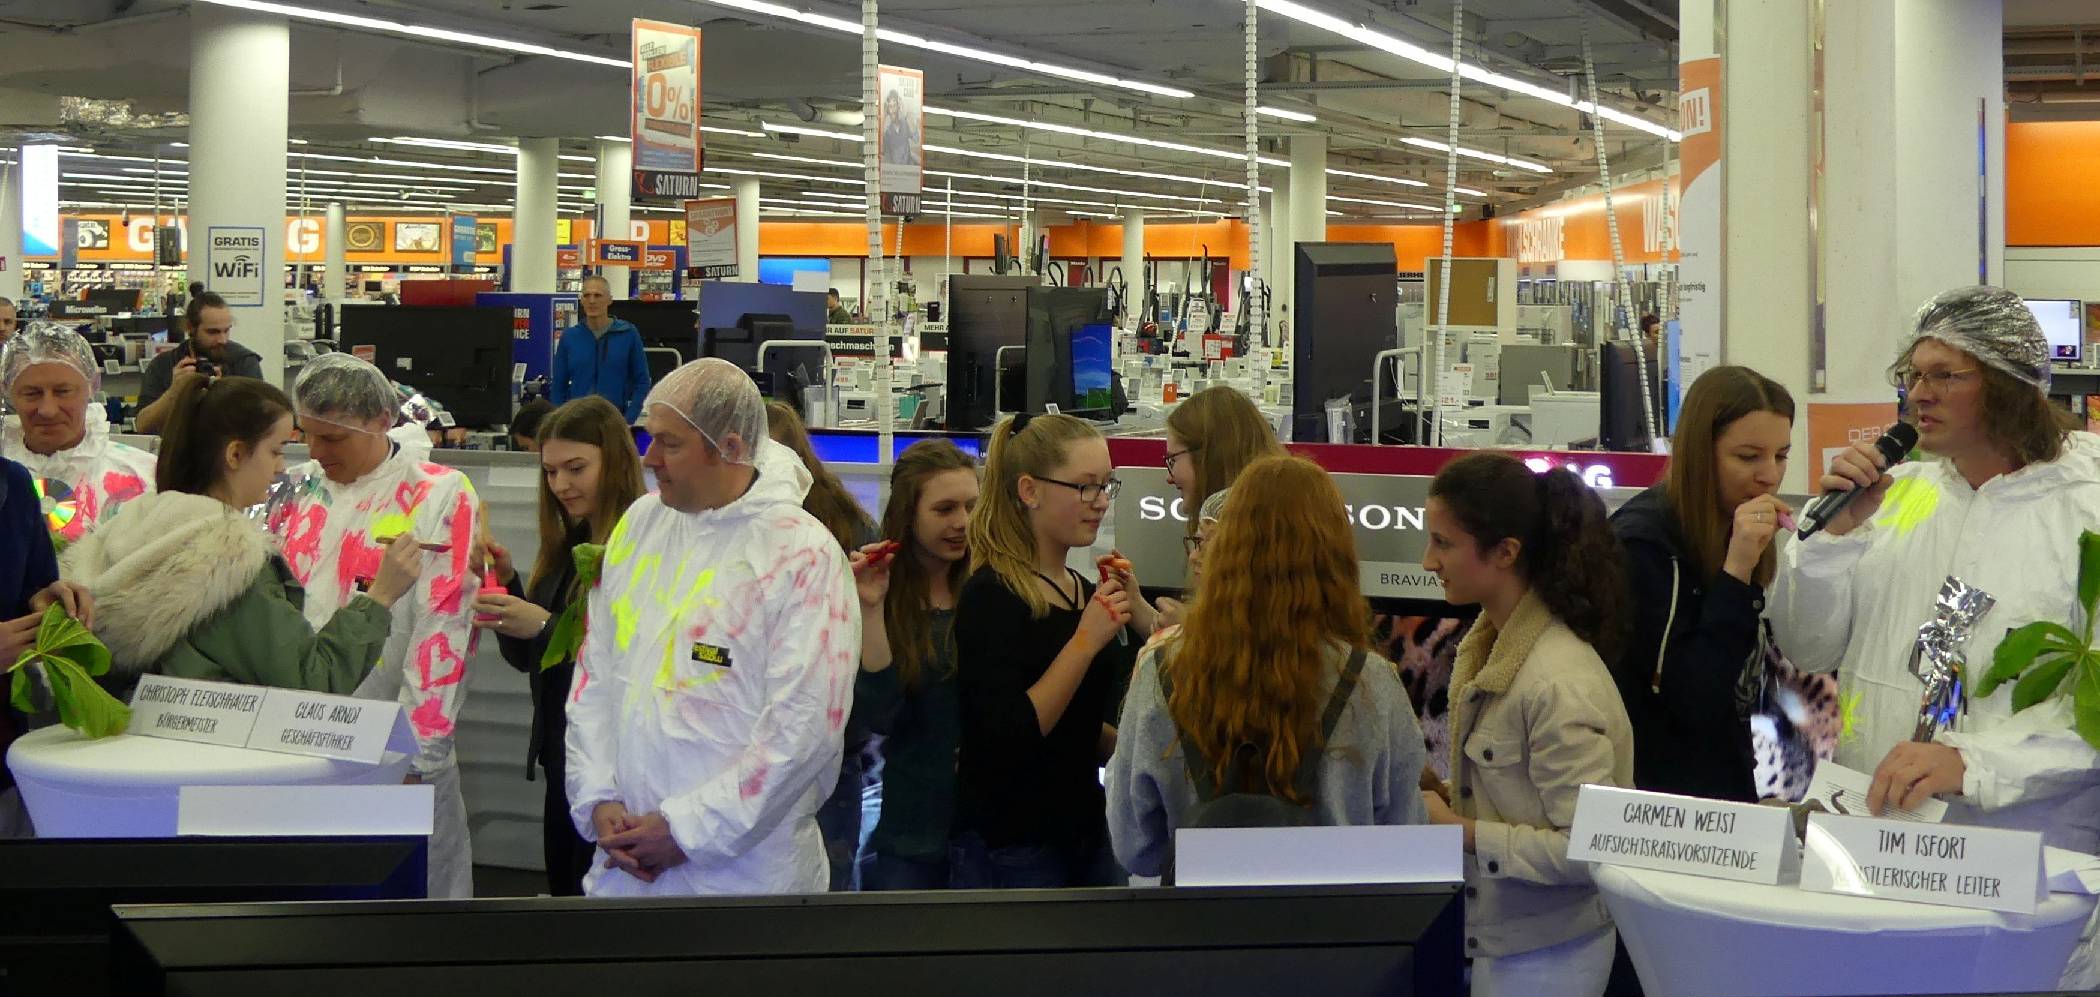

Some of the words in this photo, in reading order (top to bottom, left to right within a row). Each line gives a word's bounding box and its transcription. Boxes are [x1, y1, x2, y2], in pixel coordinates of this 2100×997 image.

[646, 72, 689, 121] 0%
[655, 174, 698, 197] SATURN
[892, 195, 921, 214] SATURN
[214, 236, 260, 247] GRATIS
[214, 261, 259, 278] WiFi
[705, 265, 739, 278] SATURN
[834, 326, 849, 334] AUF
[924, 323, 945, 332] MEHR
[1380, 573, 1438, 587] BRAVIA
[140, 684, 190, 705] CHRISTOPH
[294, 701, 327, 720] CLAUS
[1623, 801, 1687, 829] CARMEN
[1694, 809, 1737, 834] WEIST
[1589, 833, 1759, 871] AUFSICHTSRATSVORSITZENDE
[1878, 828, 1905, 855] TIM
[1915, 833, 1967, 860] ISFORT
[1956, 874, 2002, 898] LEITER
